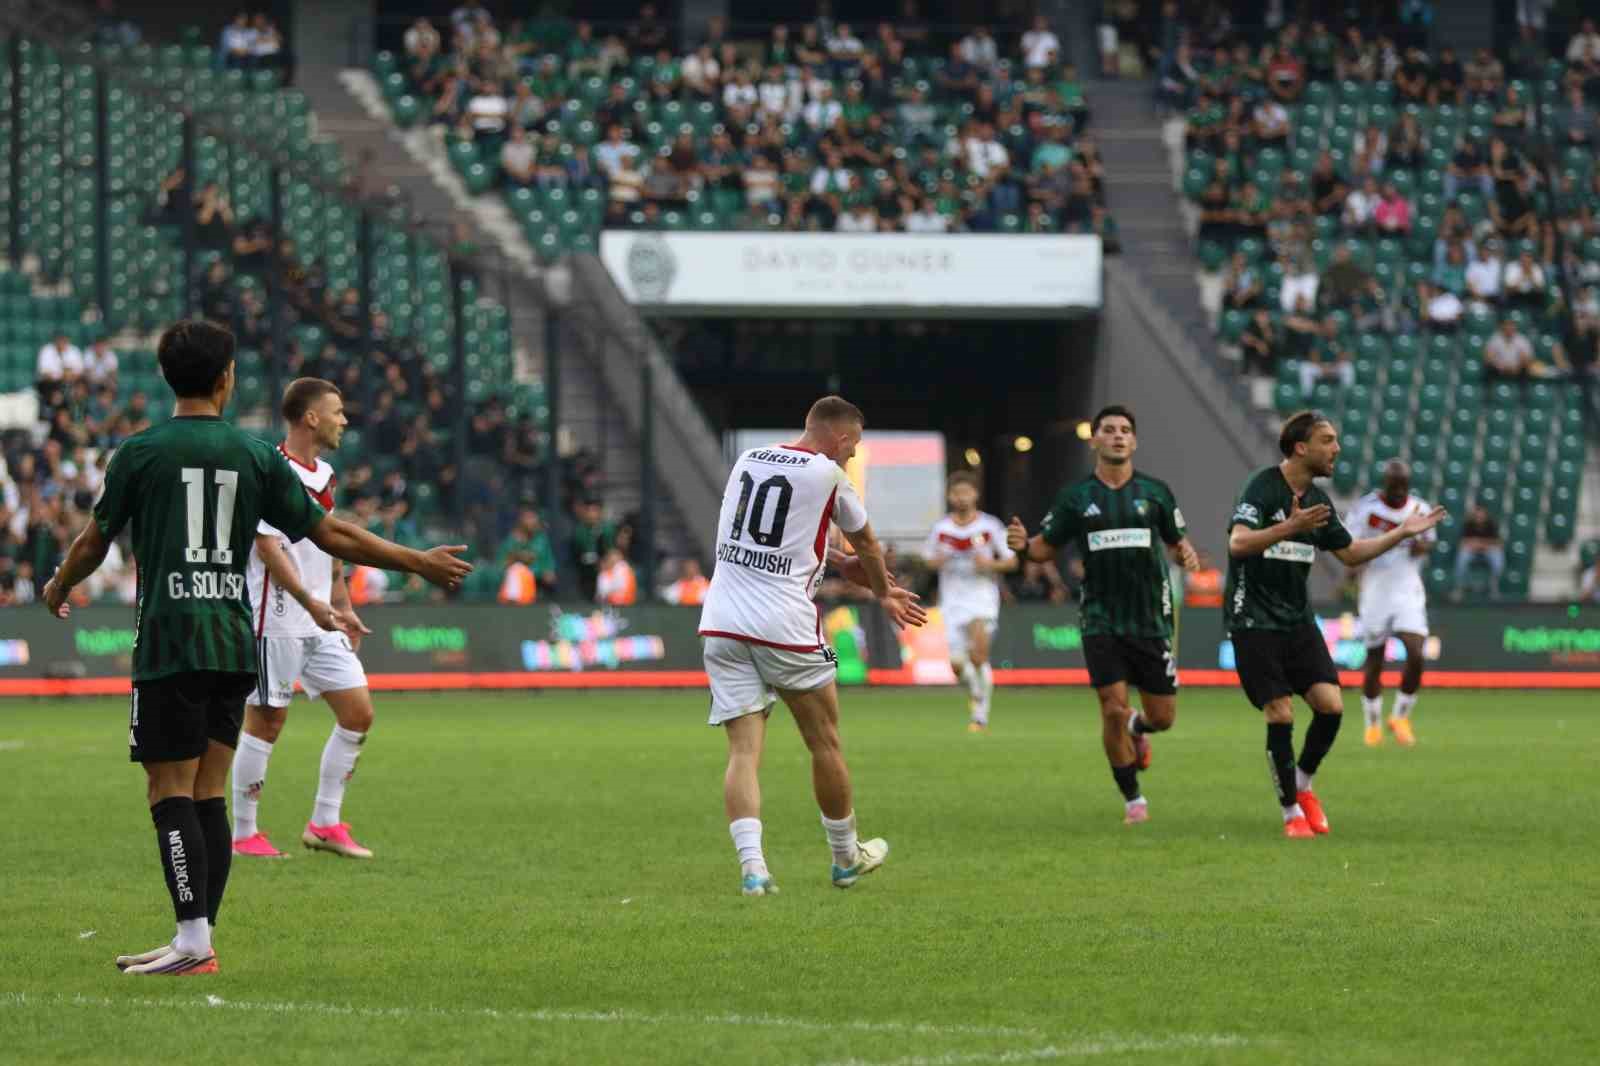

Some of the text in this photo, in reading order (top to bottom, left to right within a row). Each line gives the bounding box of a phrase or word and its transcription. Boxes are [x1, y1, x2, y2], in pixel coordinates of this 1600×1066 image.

[749, 451, 810, 465] KÖKSAN
[182, 468, 238, 564] 11
[730, 471, 793, 547] 10
